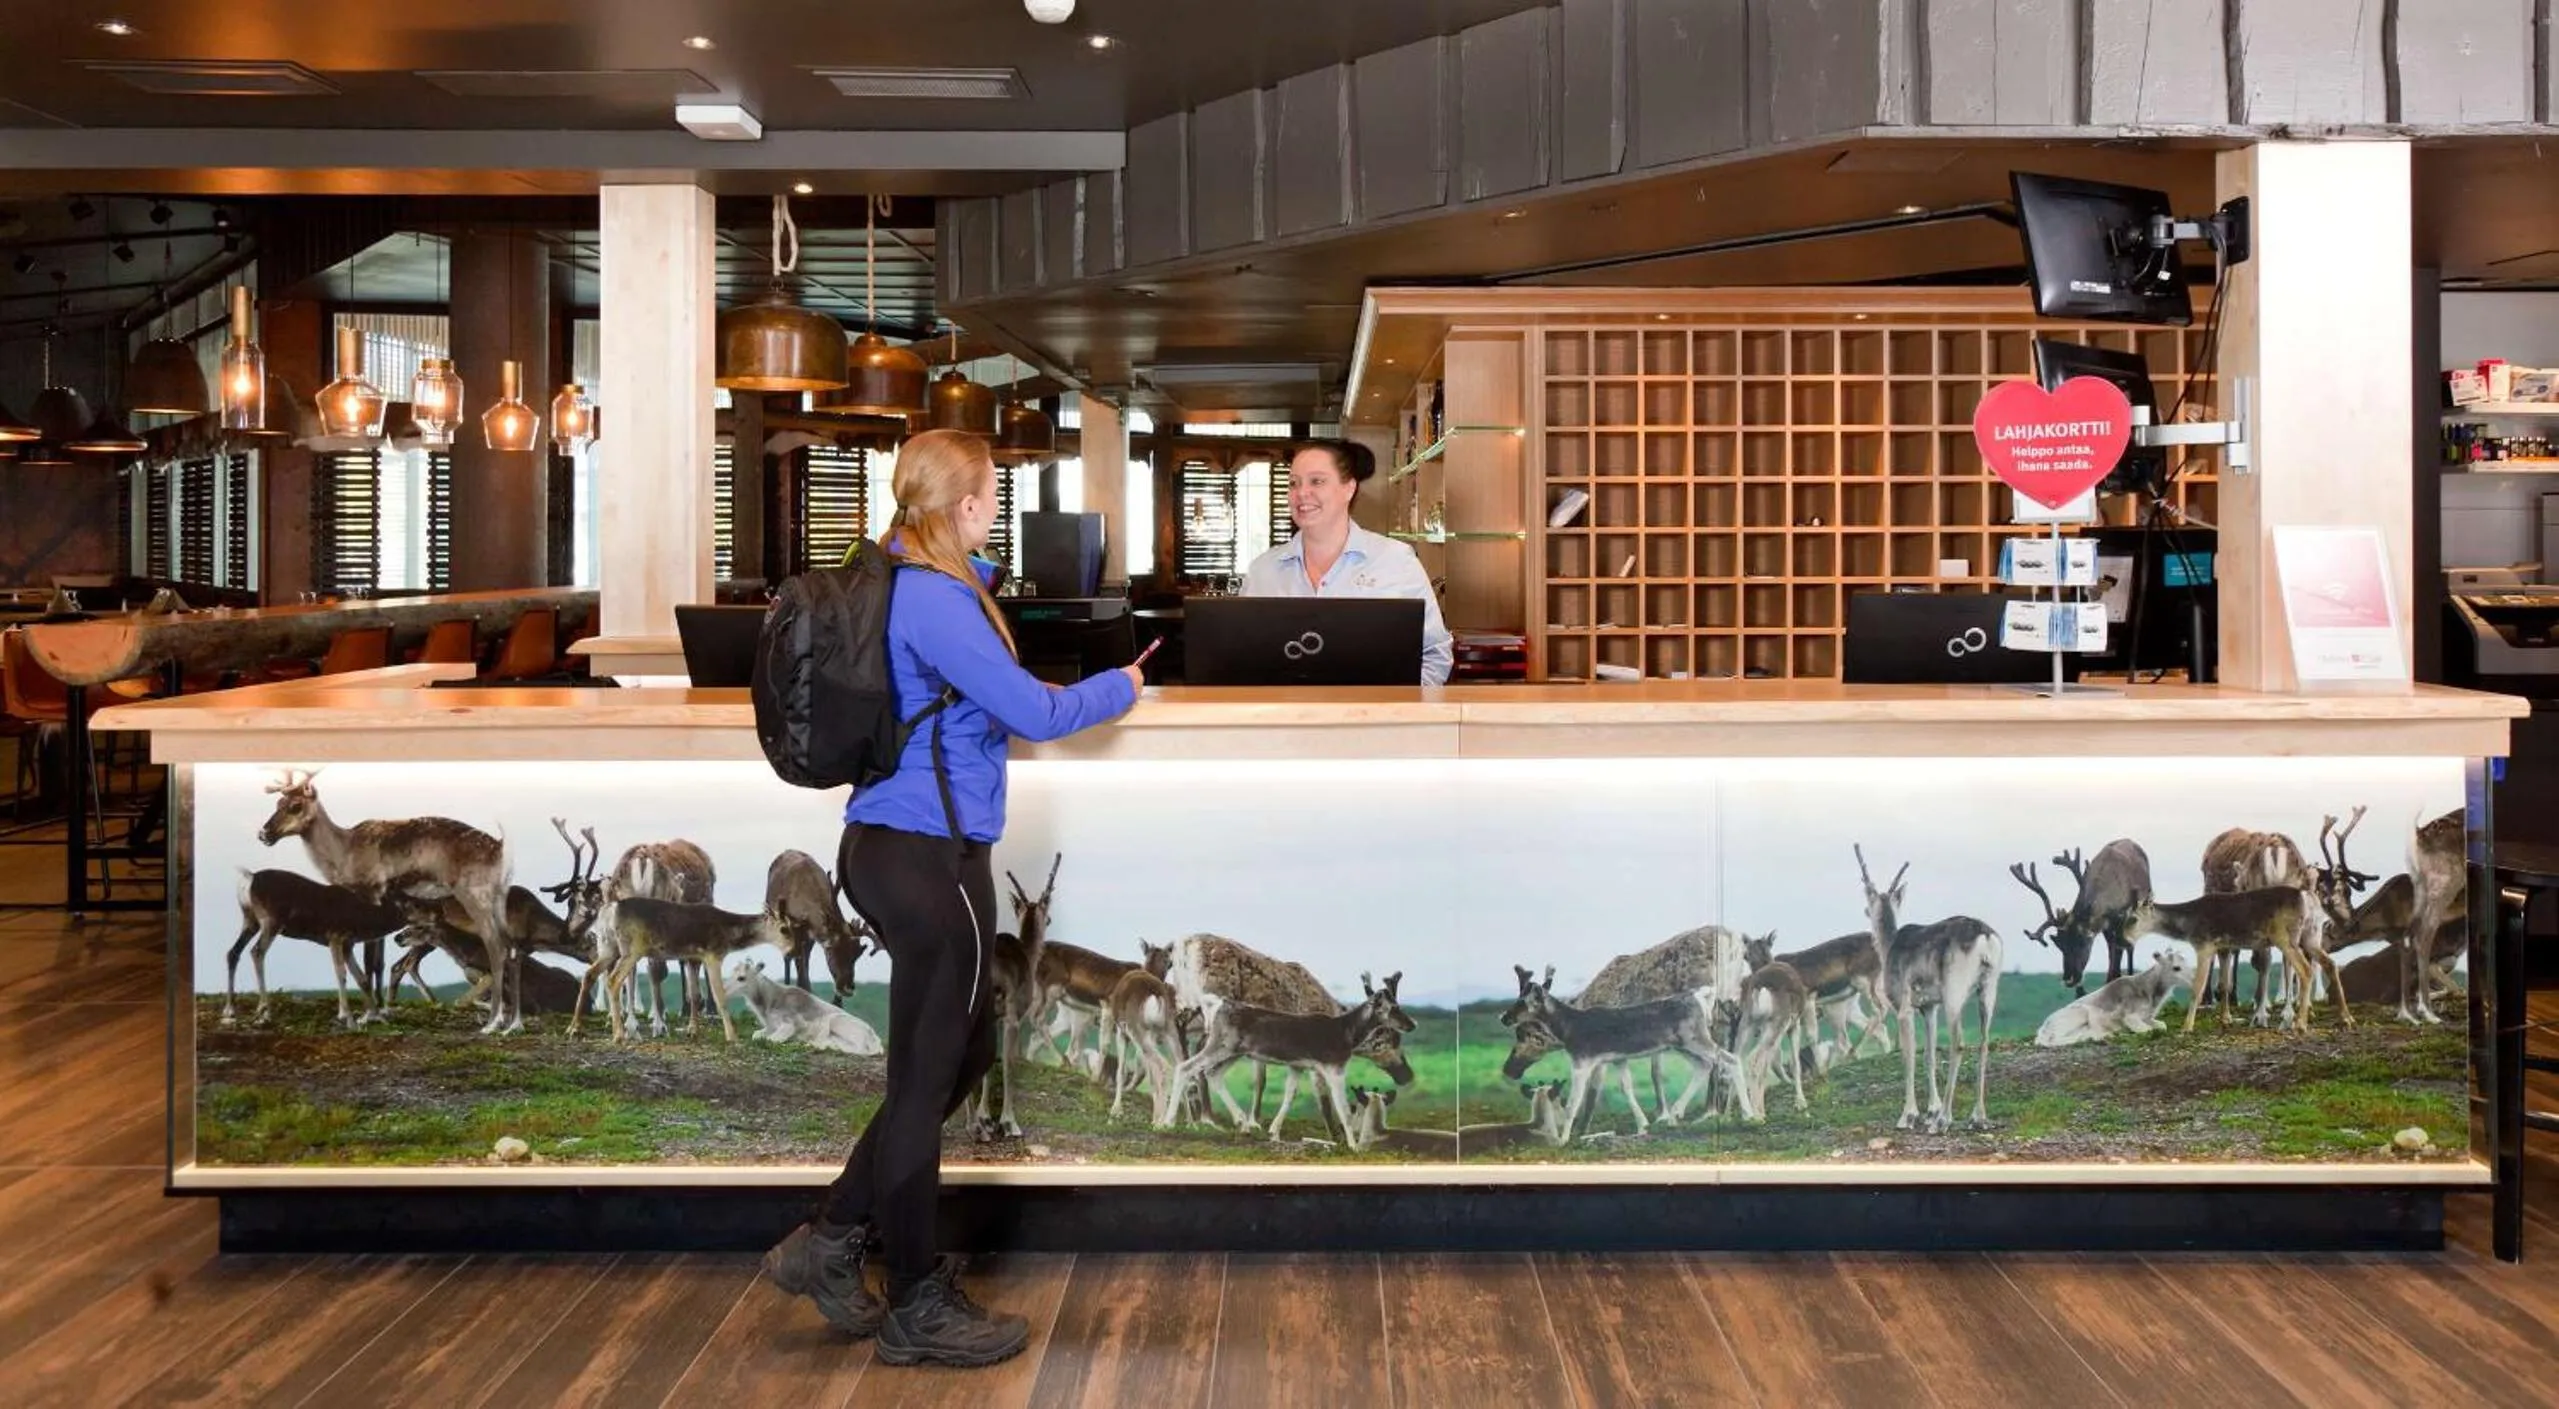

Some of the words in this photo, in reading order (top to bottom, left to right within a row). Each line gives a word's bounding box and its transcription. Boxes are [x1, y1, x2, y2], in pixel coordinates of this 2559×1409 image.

[1994, 421, 2111, 441] LAHJAKORTTI!
[2012, 445, 2054, 458] Helppo
[2056, 444, 2095, 456] antaa,
[2053, 459, 2093, 470] saada.
